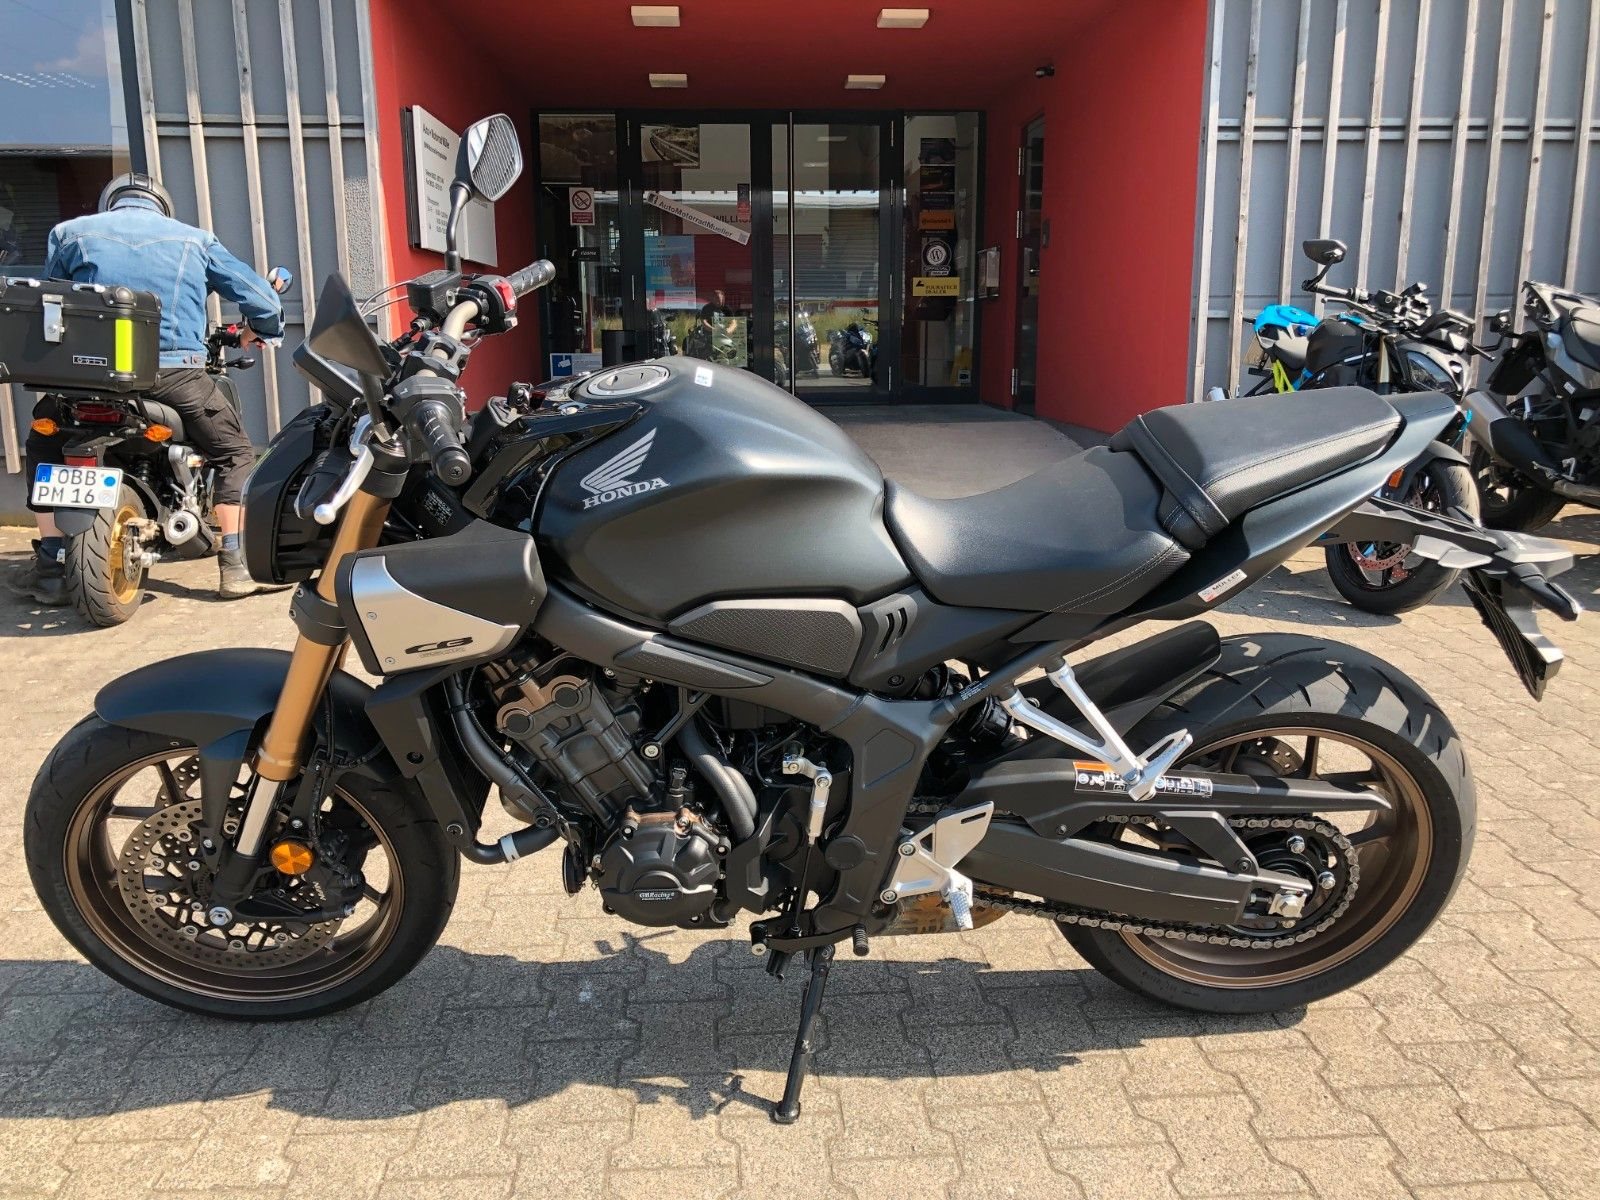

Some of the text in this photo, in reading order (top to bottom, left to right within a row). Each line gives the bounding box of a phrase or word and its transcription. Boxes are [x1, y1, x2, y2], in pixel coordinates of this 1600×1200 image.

[658, 200, 734, 238] AutoMotorradMueller
[58, 468, 97, 486] OBB
[38, 486, 95, 504] PM 16
[581, 477, 670, 510] HONDA
[405, 636, 473, 654] CB
